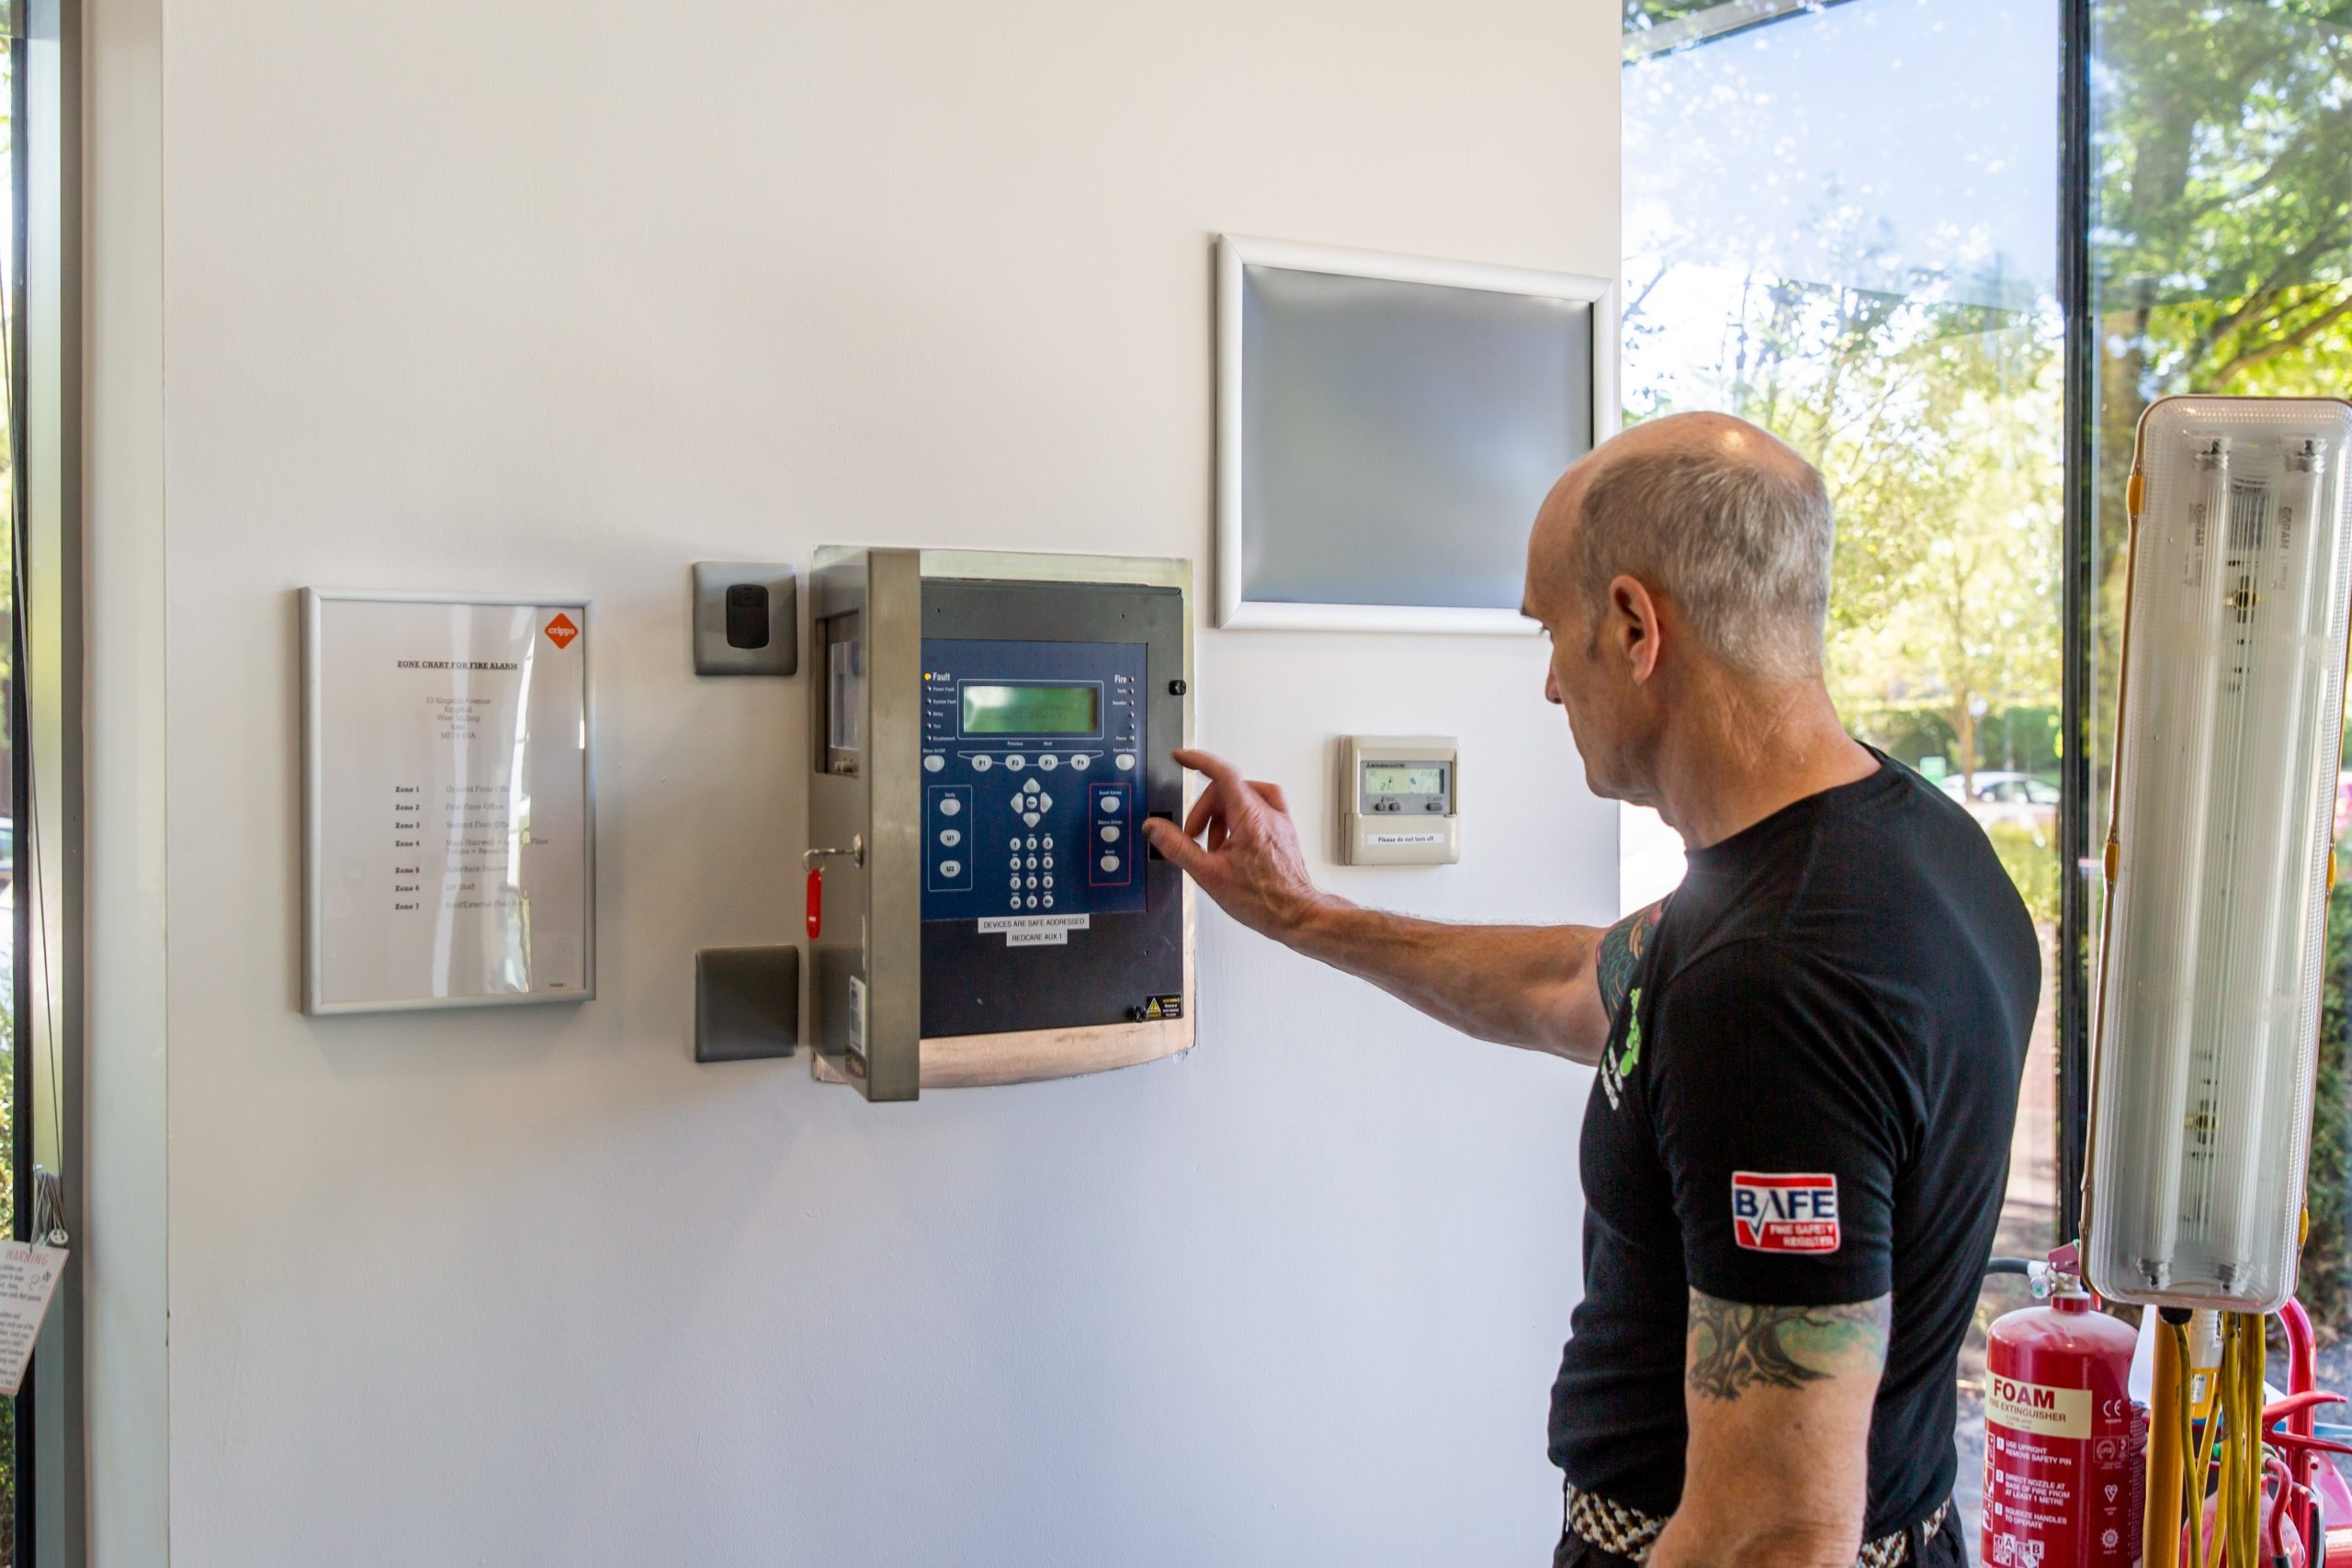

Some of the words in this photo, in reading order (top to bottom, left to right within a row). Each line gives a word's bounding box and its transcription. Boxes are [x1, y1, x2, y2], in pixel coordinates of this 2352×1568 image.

[397, 660, 420, 669] ZONE
[469, 661, 488, 670] FIRE
[489, 662, 518, 670] ALARM
[933, 672, 950, 681] Fault
[1114, 675, 1127, 683] Fire
[1046, 918, 1085, 926] ADDRESSED
[1735, 1189, 1835, 1220] BAFE
[1770, 1224, 1793, 1235] FIRE
[1795, 1224, 1834, 1235] SAFETY
[1783, 1235, 1834, 1247] REGISTER
[6, 1248, 49, 1265] WARNING
[1994, 1377, 2055, 1410] FOAM
[2001, 1403, 2066, 1422] EXTINGUISHER
[2103, 1399, 2121, 1417] CE
[2005, 1440, 2017, 1449] USE
[2018, 1443, 2048, 1455] UPRIGHT
[2005, 1447, 2030, 1461] REMOVE
[2031, 1453, 2058, 1465] SAFETY
[2059, 1457, 2072, 1466] PIN
[2005, 1472, 2027, 1484] DIRECT
[2028, 1478, 2055, 1489] NOZZLE
[2005, 1480, 2020, 1490] BASE
[2021, 1484, 2031, 1492] OF
[2032, 1487, 2047, 1495] FIRE
[2048, 1489, 2071, 1499] FROM
[2013, 1490, 2033, 1502] LEAST
[2039, 1496, 2064, 1507] METRE
[2005, 1506, 2033, 1519] SQUEEZE
[2034, 1513, 2067, 1525] HANDLES
[2005, 1514, 2013, 1523] TO
[2013, 1517, 2043, 1529] OPERATE
[2005, 1538, 2013, 1548] A
[2033, 1543, 2041, 1554] B
